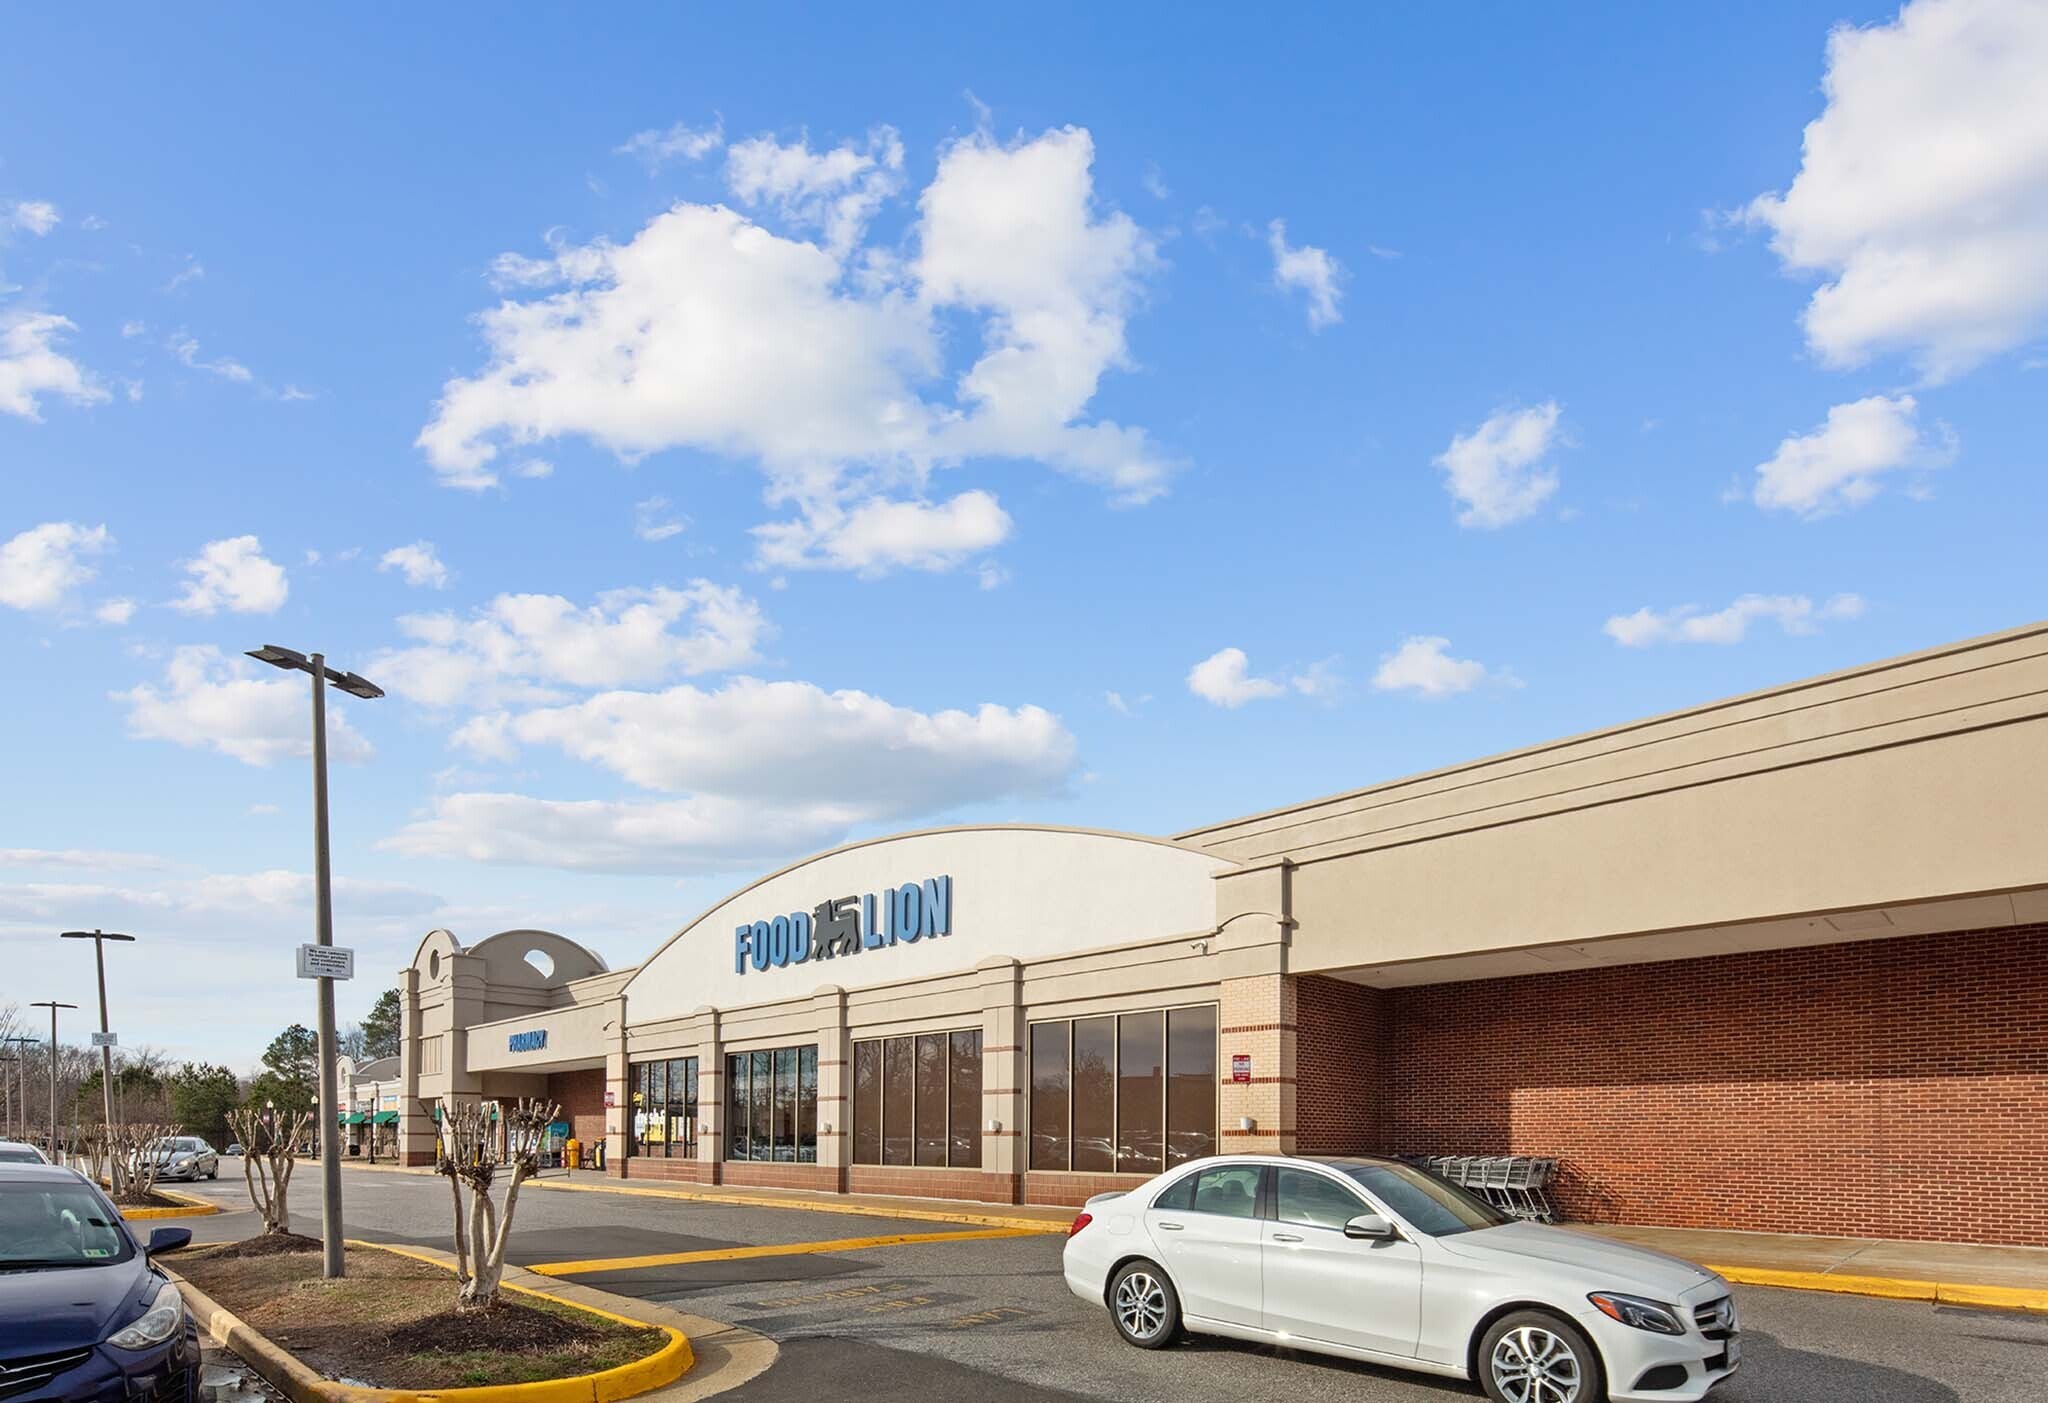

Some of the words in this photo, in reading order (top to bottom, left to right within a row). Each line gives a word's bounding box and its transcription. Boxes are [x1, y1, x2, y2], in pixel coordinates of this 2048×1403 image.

[735, 911, 813, 976] FOOD
[863, 874, 952, 950] LION
[509, 1029, 548, 1052] PHARMACY
